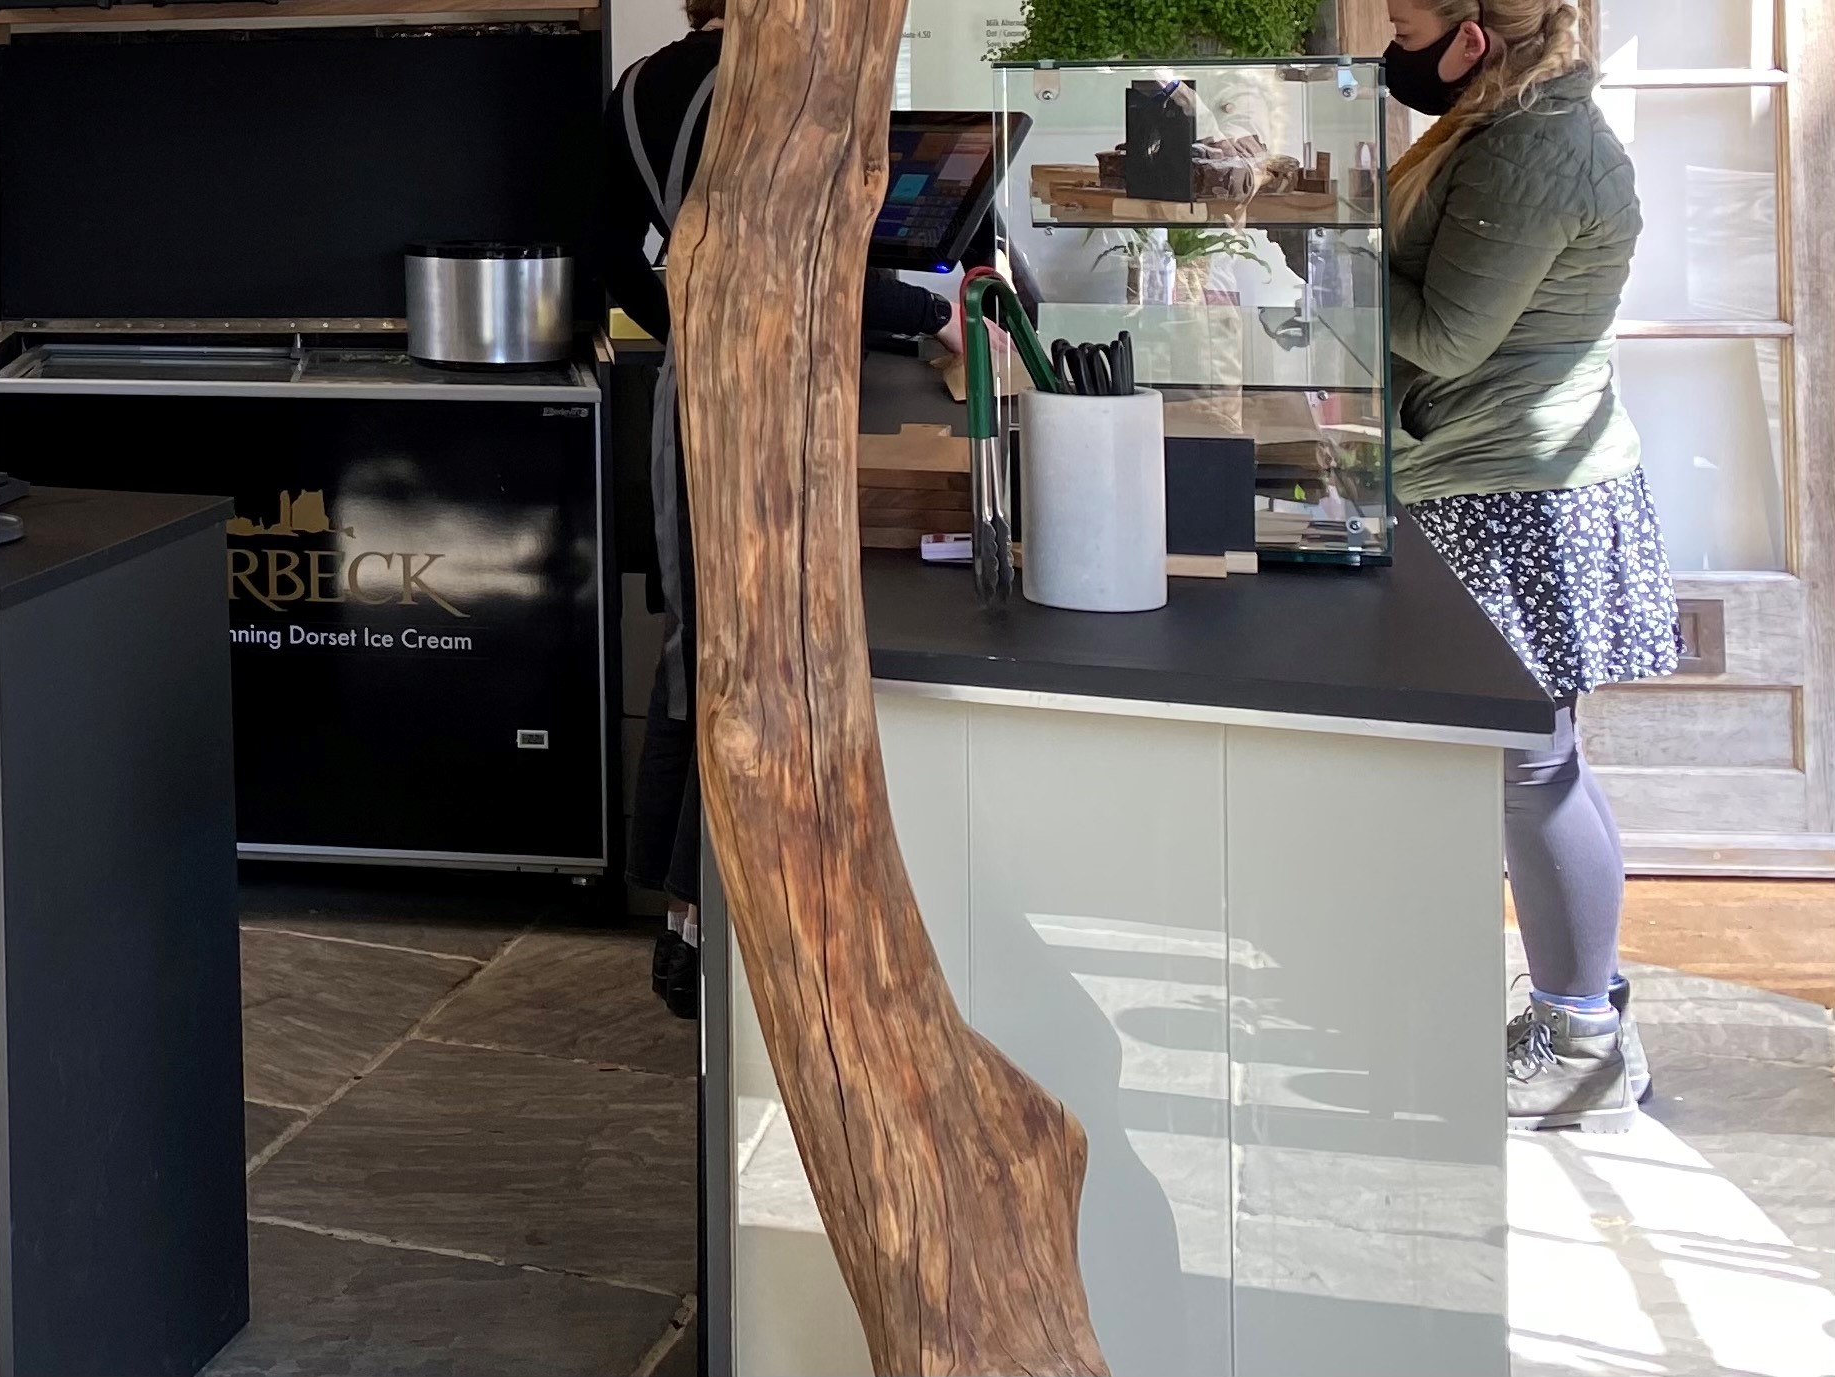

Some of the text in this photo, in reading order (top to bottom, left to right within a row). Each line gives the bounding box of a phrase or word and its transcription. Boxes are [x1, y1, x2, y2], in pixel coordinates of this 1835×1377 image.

[227, 548, 471, 618] RBECK
[229, 624, 473, 651] nning Dorset Ice Cream
